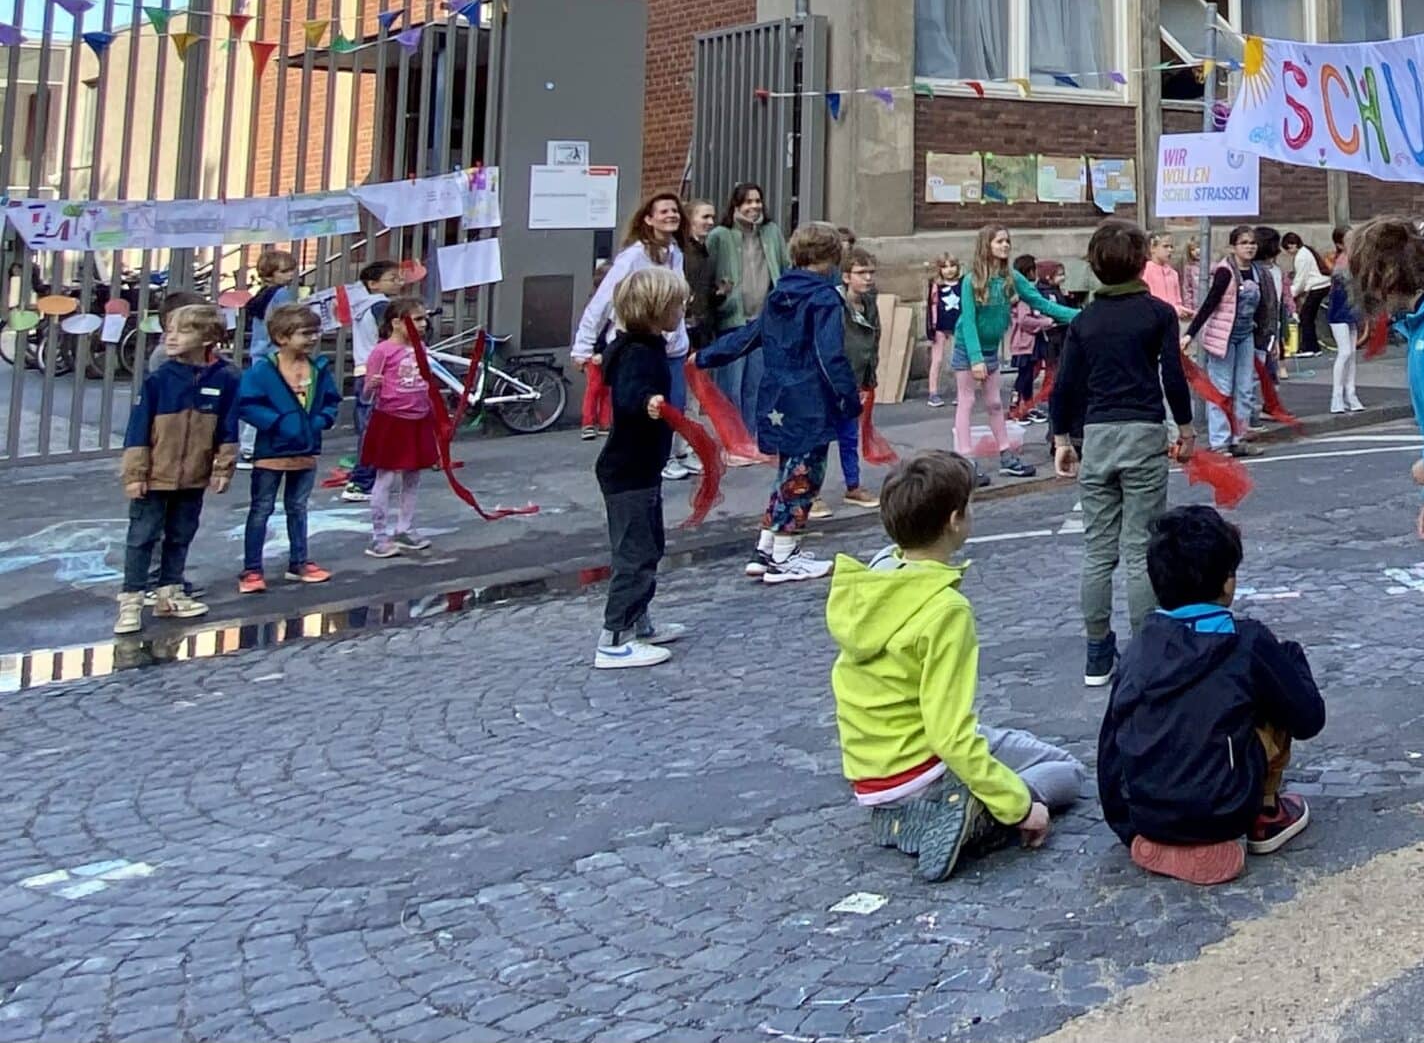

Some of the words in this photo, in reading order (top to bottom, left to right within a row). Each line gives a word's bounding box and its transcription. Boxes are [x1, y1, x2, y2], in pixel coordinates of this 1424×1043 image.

[1164, 148, 1187, 166] WIR
[1163, 166, 1210, 185] WOLLEN
[1194, 186, 1249, 202] STRASSEN
